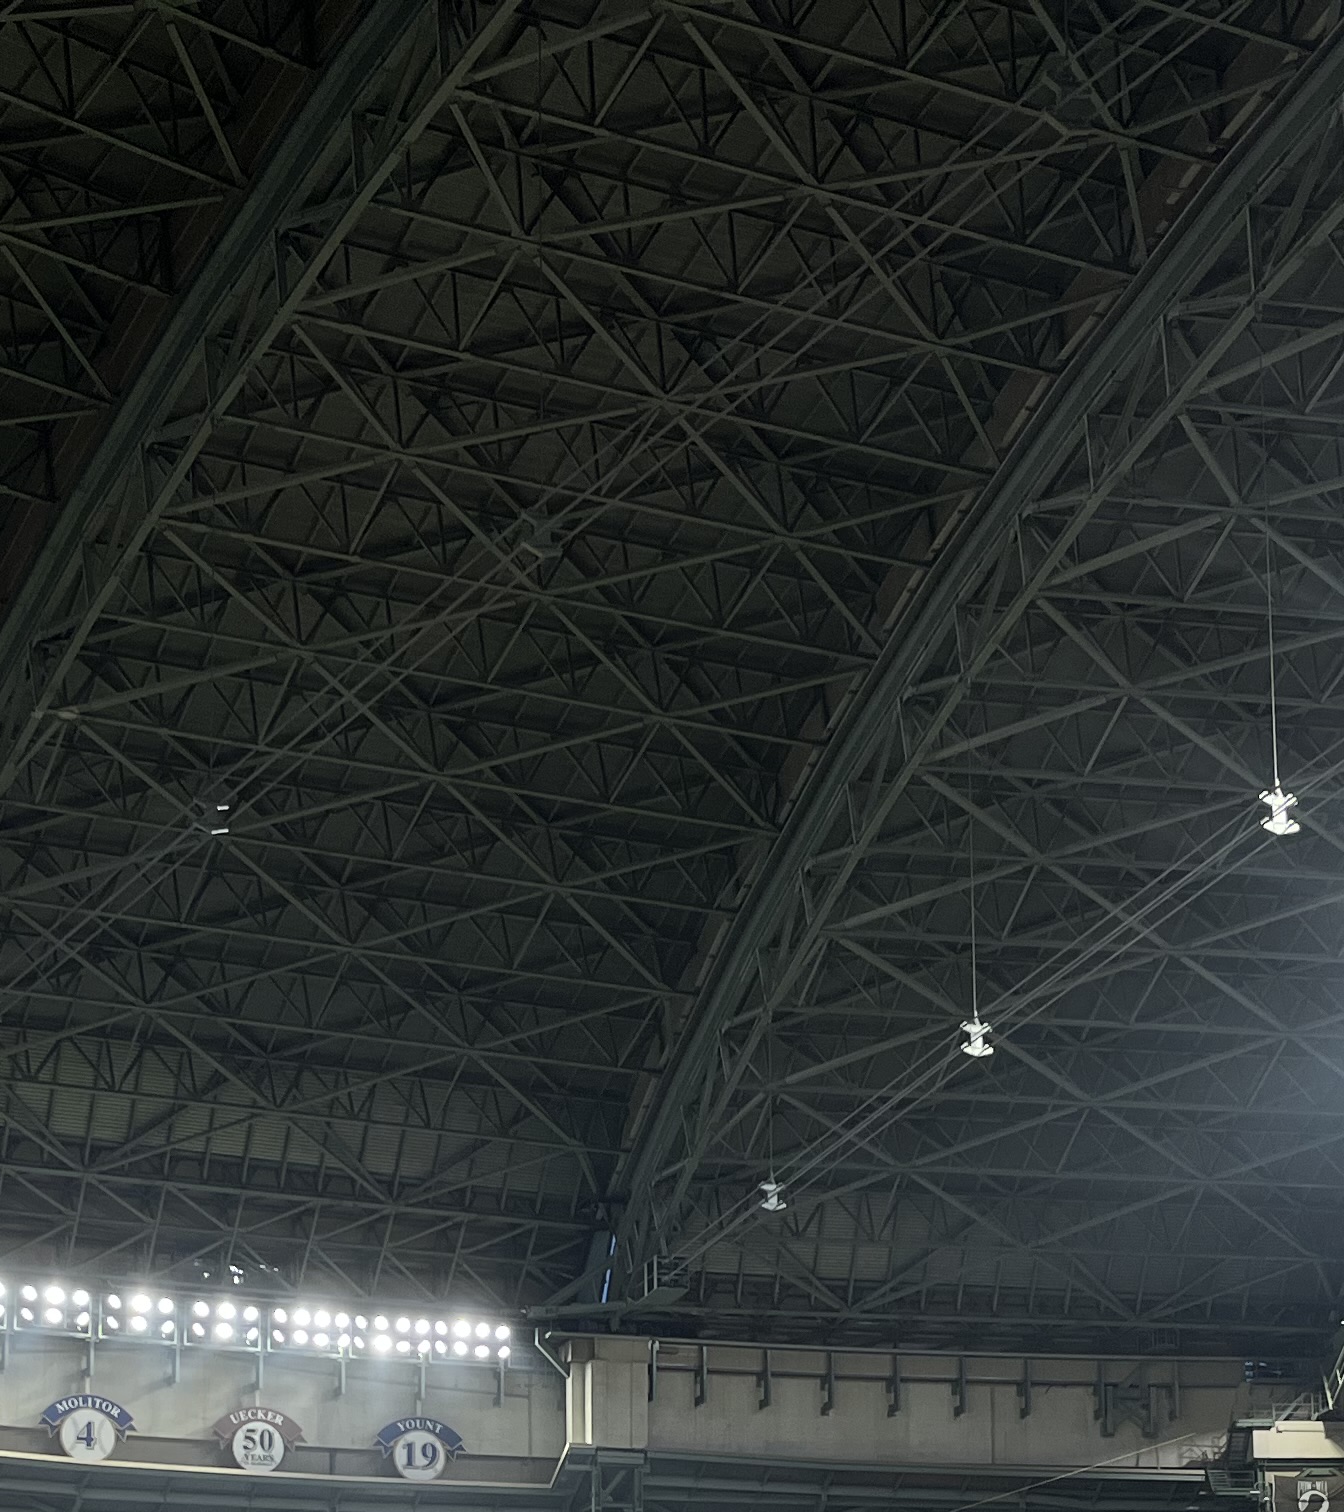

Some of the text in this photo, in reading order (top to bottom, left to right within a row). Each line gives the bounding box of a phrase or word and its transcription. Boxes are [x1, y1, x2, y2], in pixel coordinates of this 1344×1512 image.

[55, 1397, 121, 1419] MOLITOR
[229, 1410, 284, 1427] UECKER
[76, 1421, 96, 1450] 4
[396, 1417, 444, 1434] YOUNT
[243, 1428, 275, 1453] 50
[402, 1441, 437, 1470] 19
